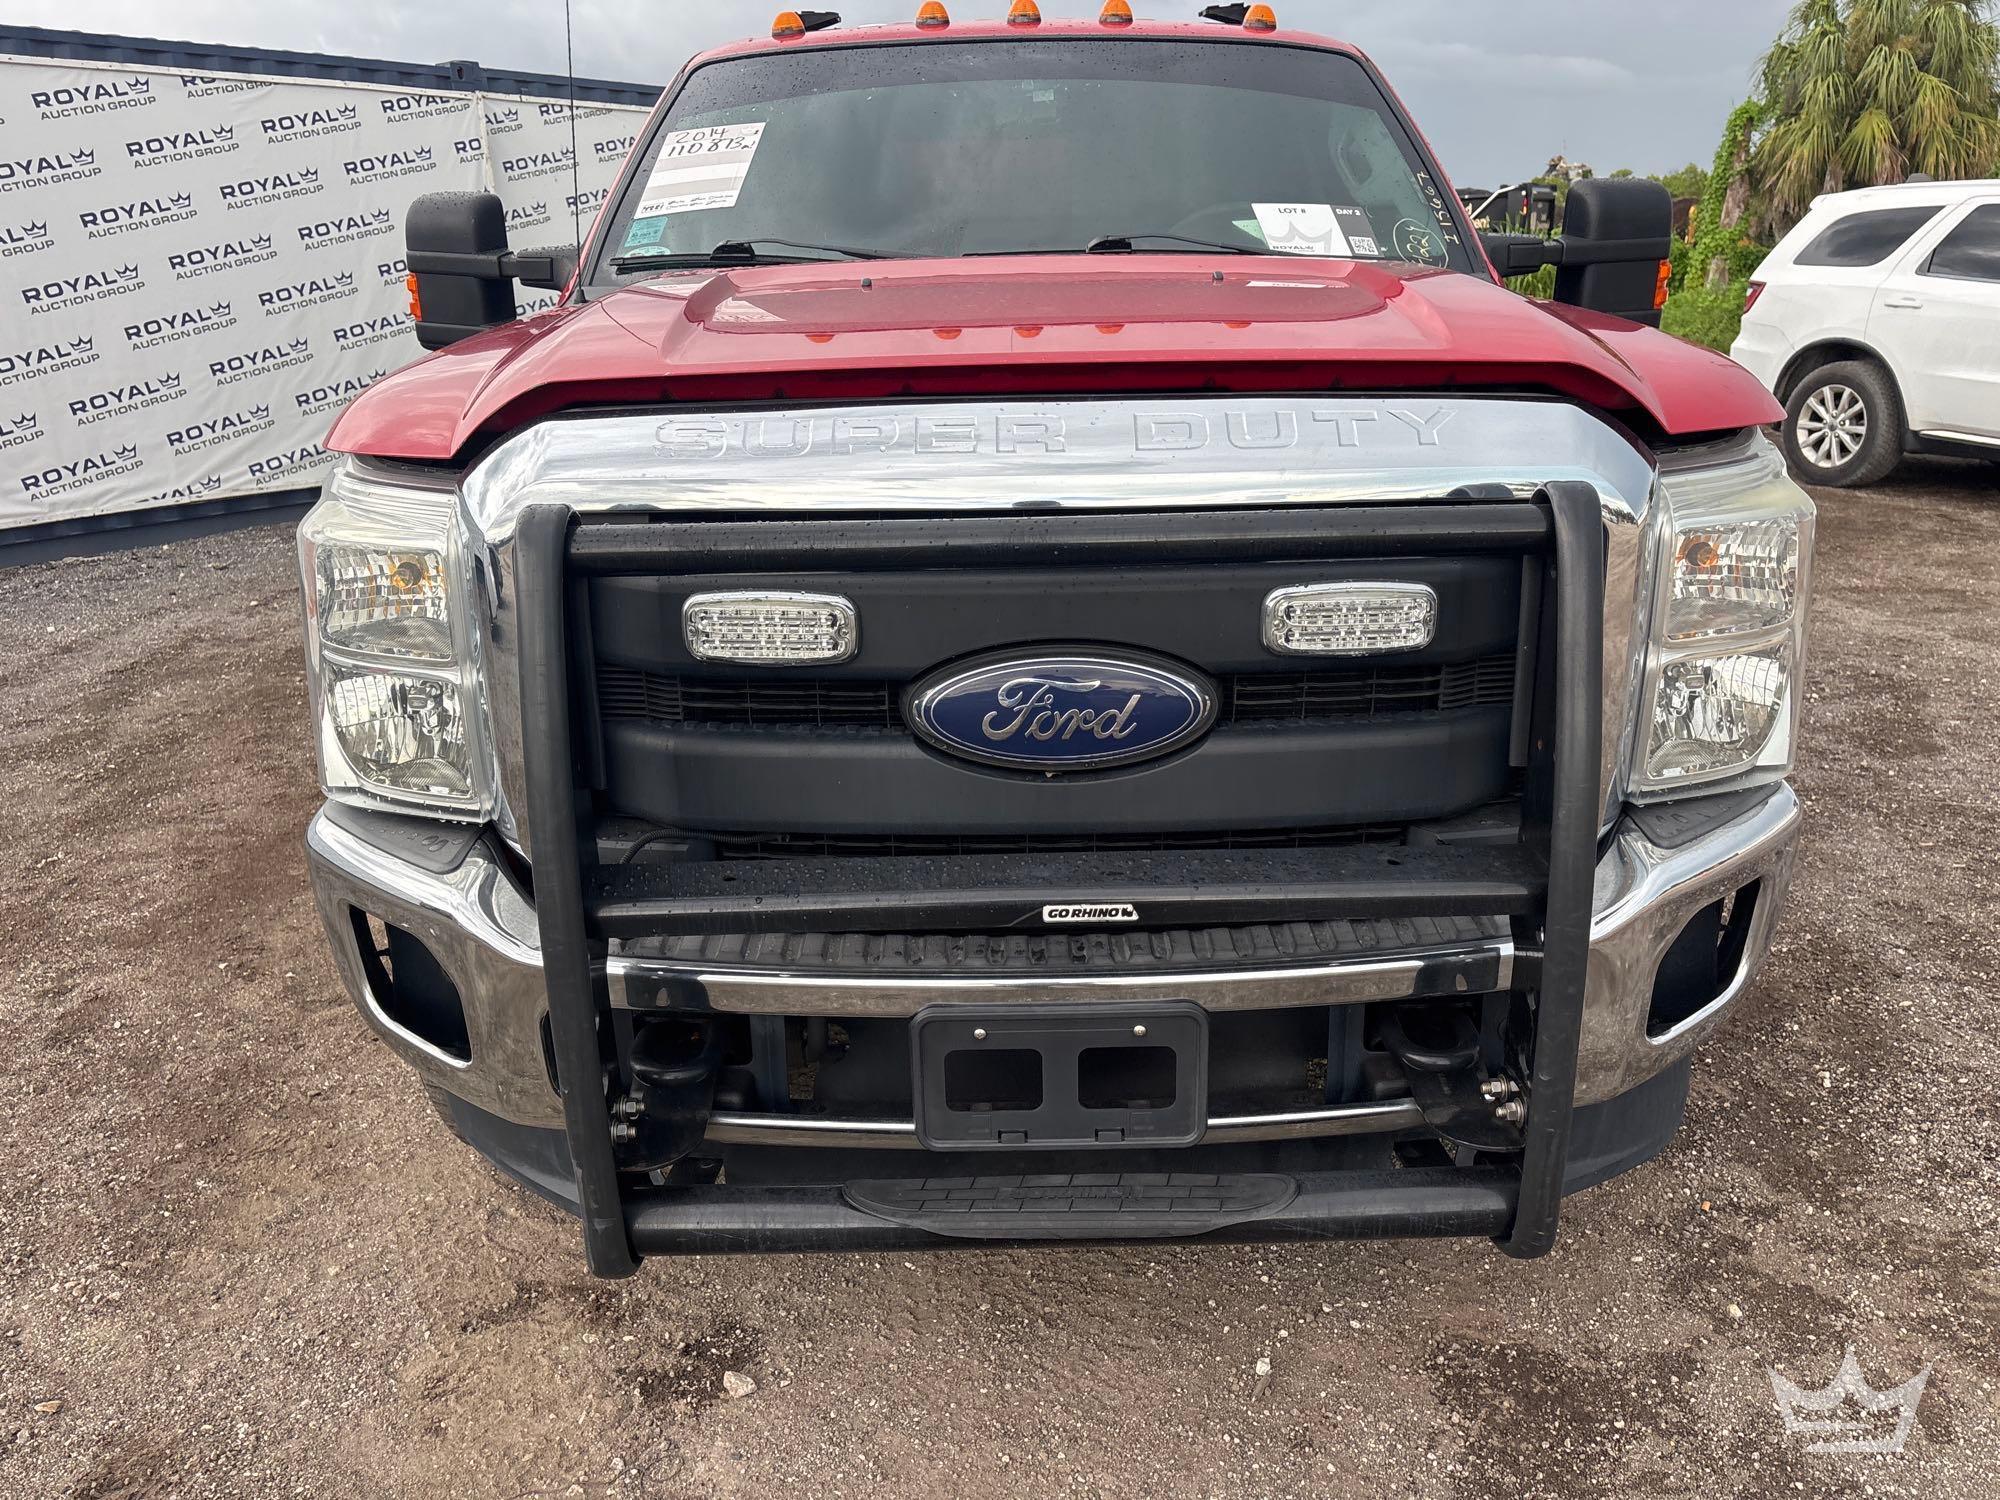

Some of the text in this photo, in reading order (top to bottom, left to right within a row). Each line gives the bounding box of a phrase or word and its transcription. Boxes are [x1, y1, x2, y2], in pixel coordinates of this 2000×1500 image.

[31, 82, 128, 108] ROYAL
[187, 83, 244, 99] AUCTION
[41, 96, 156, 120] AUCTION GROUP
[261, 109, 339, 133] ROYAL
[387, 103, 470, 124] AUCTION GROUP
[267, 121, 361, 145] AUCTION GROUP
[490, 123, 523, 135] GROUP
[675, 128, 728, 144] 2014
[126, 130, 214, 157] ROYAL
[134, 143, 240, 168] AUCTION GROUP
[594, 136, 636, 154] ROYA
[0, 155, 72, 179] OYAL
[343, 151, 416, 175] ROYAL
[460, 153, 485, 164] AUCT
[502, 152, 562, 173] ROYAL
[0, 167, 101, 192] CTION GROUP
[219, 173, 300, 200] ROYAL
[350, 162, 437, 186] AUCTION GROUP
[507, 168, 548, 182] AUCTION
[227, 184, 324, 211] AUCTION GROUP
[80, 198, 172, 228] ROYAL
[88, 210, 197, 239] AUCTION GROUP
[520, 216, 551, 229] GROUP
[297, 214, 373, 241] ROYAL
[304, 224, 395, 251] AUCTION GROUP
[2, 240, 54, 257] GROUP
[168, 240, 253, 270] ROYAL
[176, 250, 277, 281] AUCTION GROUP
[21, 271, 117, 304] ROYAL
[31, 281, 145, 315] AUCTION GROUP
[258, 278, 336, 307] ROYAL
[265, 287, 358, 317] AUCTION GROUP
[515, 296, 556, 316] OYAL
[124, 308, 212, 341] ROYAL
[132, 317, 237, 351] AUCTION GROUP
[333, 314, 405, 342] ROYAL
[339, 325, 417, 352] AUCTION GROU
[0, 345, 71, 373] OYAL
[0, 353, 100, 387] CTION GROUP
[209, 345, 290, 376] ROYAL
[216, 353, 314, 387] AUCTION GROUP
[68, 381, 160, 416] ROYAL
[295, 377, 369, 407] ROYAL
[77, 388, 187, 427] AUCTION GROUP
[0, 430, 44, 450] ROUP
[166, 413, 251, 447] ROYAL
[174, 420, 275, 457] AUCTION GROUP
[654, 409, 1458, 458] SUPER DUTY
[20, 453, 116, 491] ROYAL
[248, 443, 326, 476] ROYAL
[30, 460, 144, 502] AUCTION GROUP
[255, 464, 307, 486] AUCTION
[982, 677, 1140, 741] Ford
